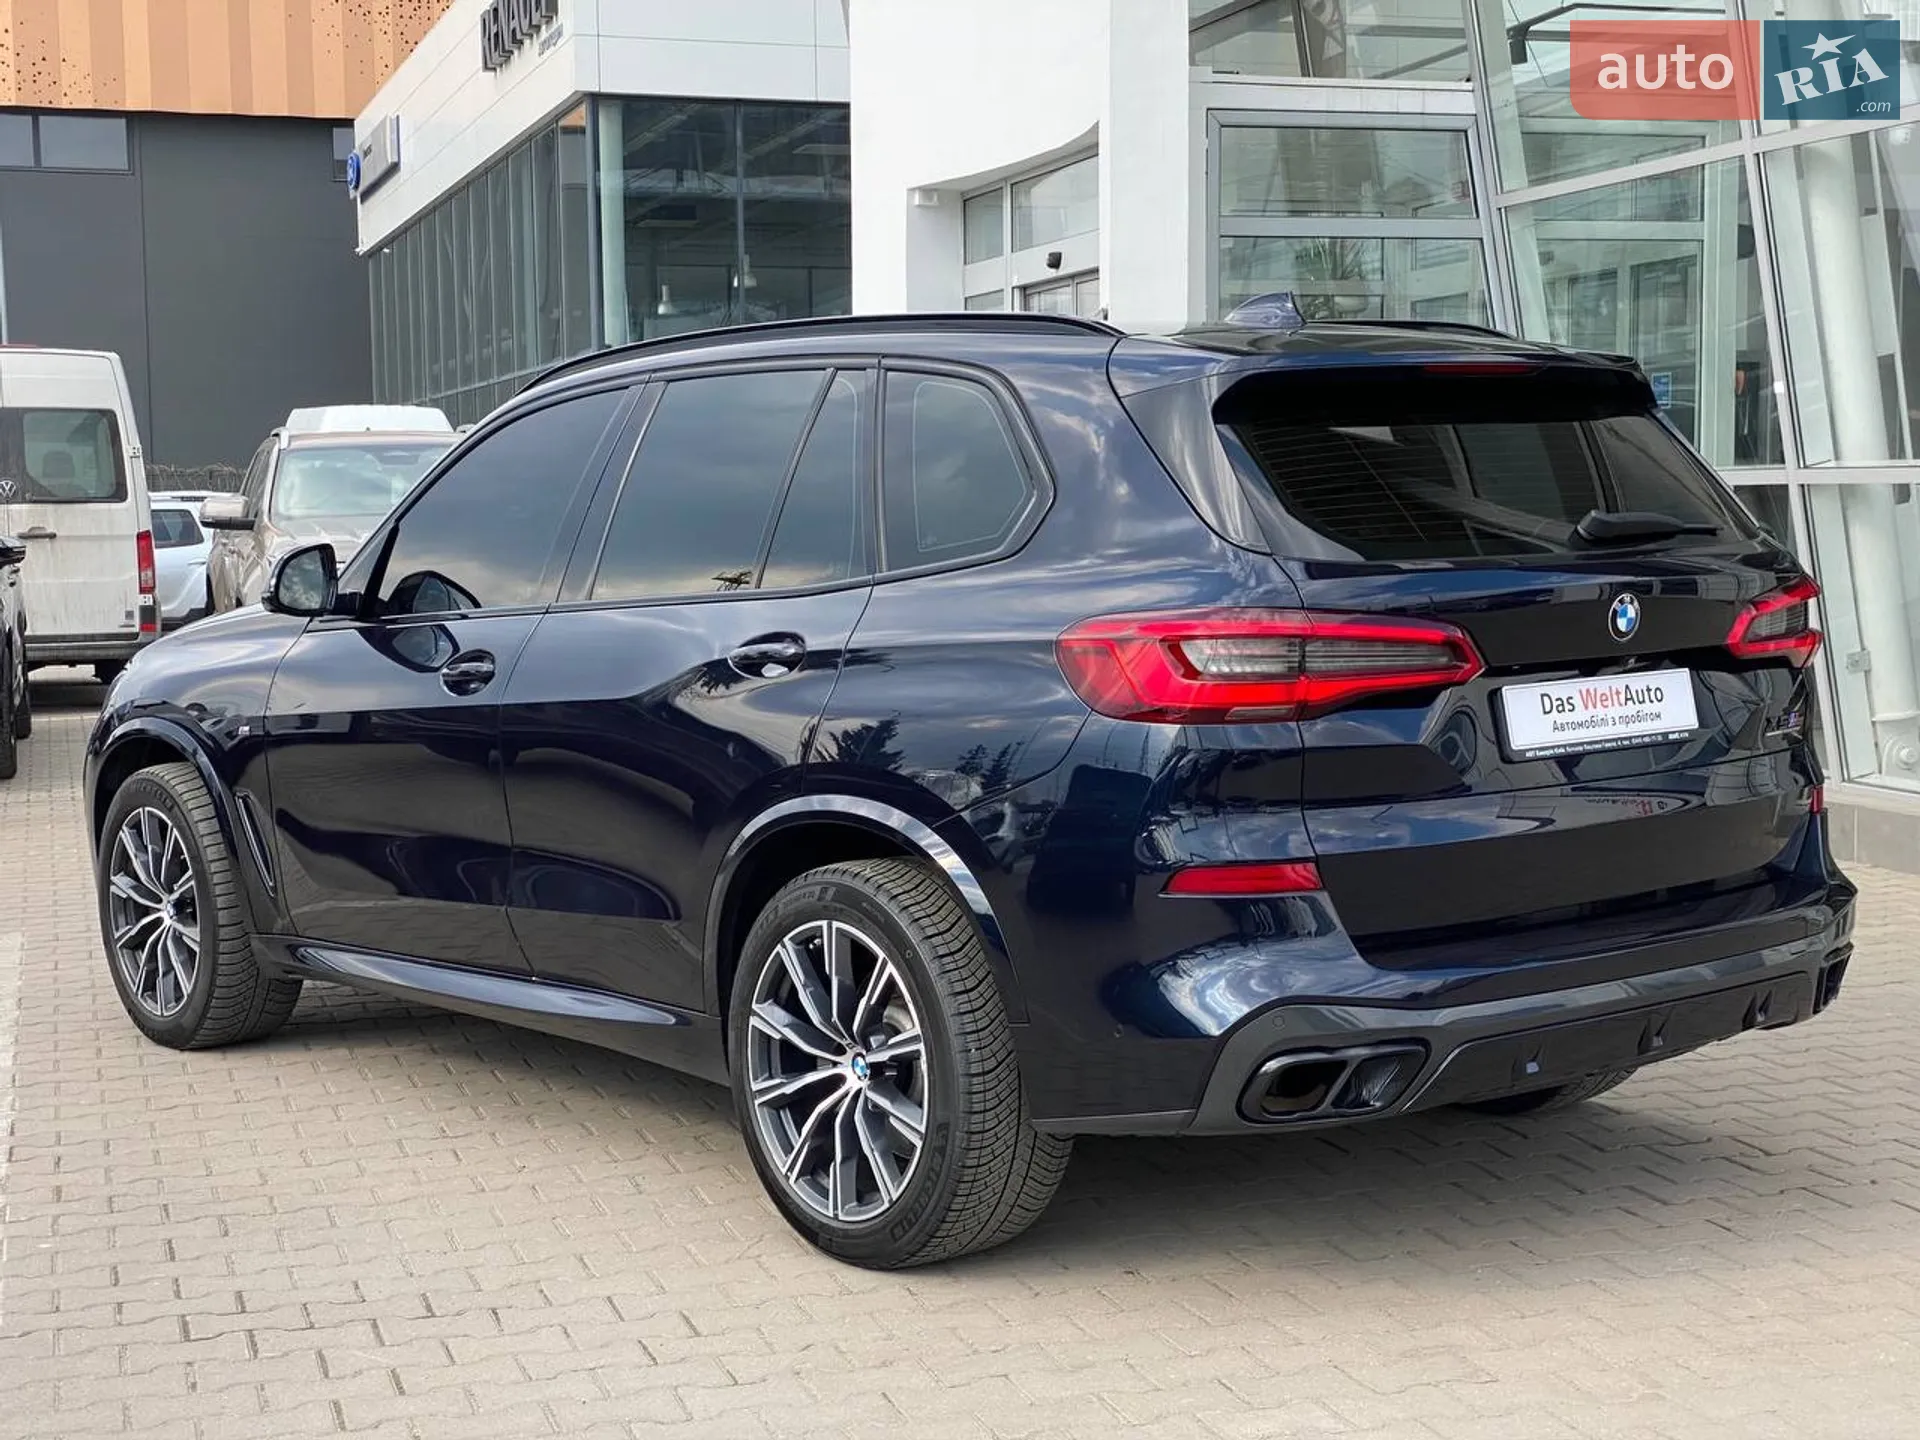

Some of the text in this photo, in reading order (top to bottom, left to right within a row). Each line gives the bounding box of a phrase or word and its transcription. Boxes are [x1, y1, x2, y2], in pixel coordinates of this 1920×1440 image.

[1540, 684, 1664, 715] Das WeltAuto
[1552, 713, 1609, 733] Автомобілі
[1618, 709, 1662, 728] пробігом
